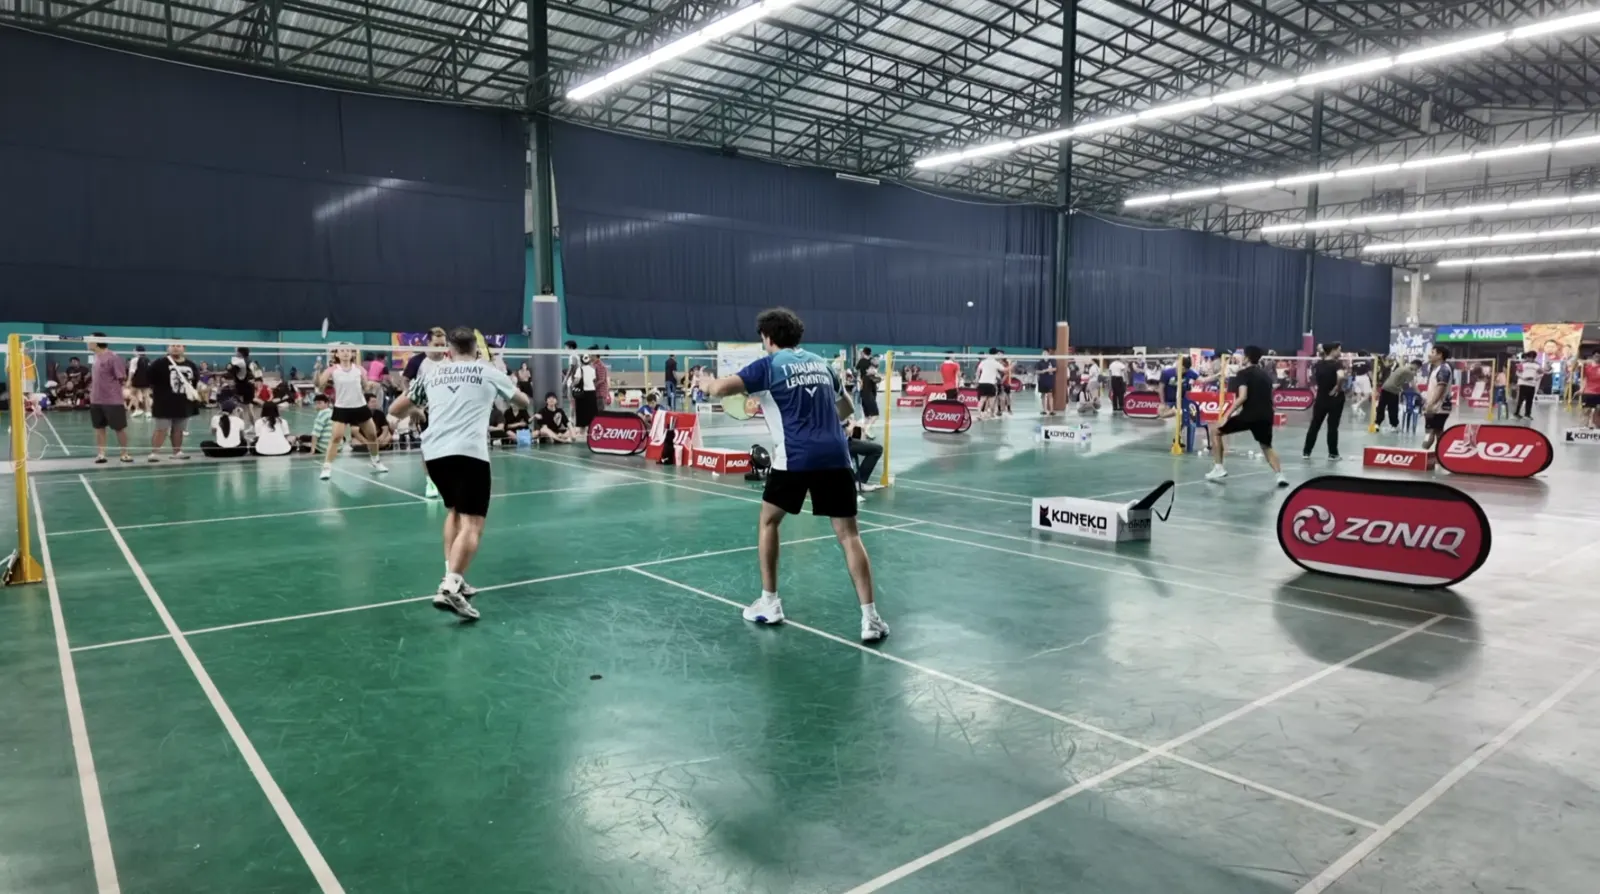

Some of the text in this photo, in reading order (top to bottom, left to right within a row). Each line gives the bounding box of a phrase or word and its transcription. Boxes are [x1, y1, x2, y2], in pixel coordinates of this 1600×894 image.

[1472, 328, 1507, 338] YONEX
[438, 366, 483, 375] DELAUNAY
[781, 364, 788, 376] T
[431, 375, 483, 387] LEADMINTON
[934, 412, 960, 422] ZONIQ
[603, 428, 637, 442] ZONIQ
[1574, 432, 1600, 440] KONE
[1444, 440, 1534, 463] BAOJI
[1374, 453, 1414, 466] BAOJI
[1052, 509, 1107, 530] KONEKO
[1336, 517, 1466, 558] ZONIQ
